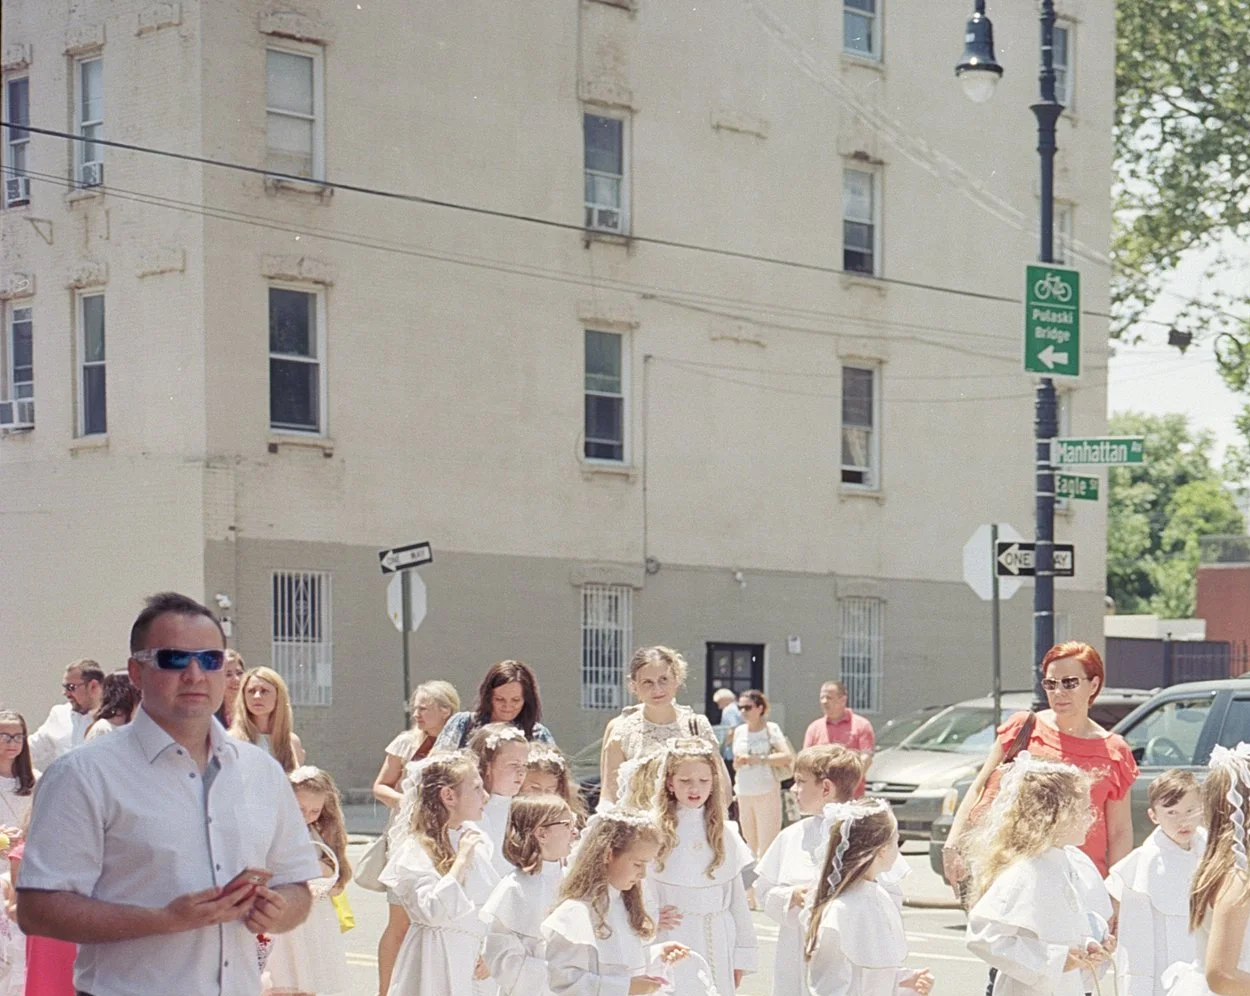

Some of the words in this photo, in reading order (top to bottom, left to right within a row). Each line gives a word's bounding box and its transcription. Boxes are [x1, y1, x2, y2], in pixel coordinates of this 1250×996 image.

[1032, 308, 1073, 324] Pulaski
[1035, 326, 1071, 343] Bridge
[1056, 441, 1128, 464] Manhattan
[1056, 475, 1087, 498] Eagle
[1005, 552, 1031, 566] ONE
[1053, 553, 1067, 566] AY
